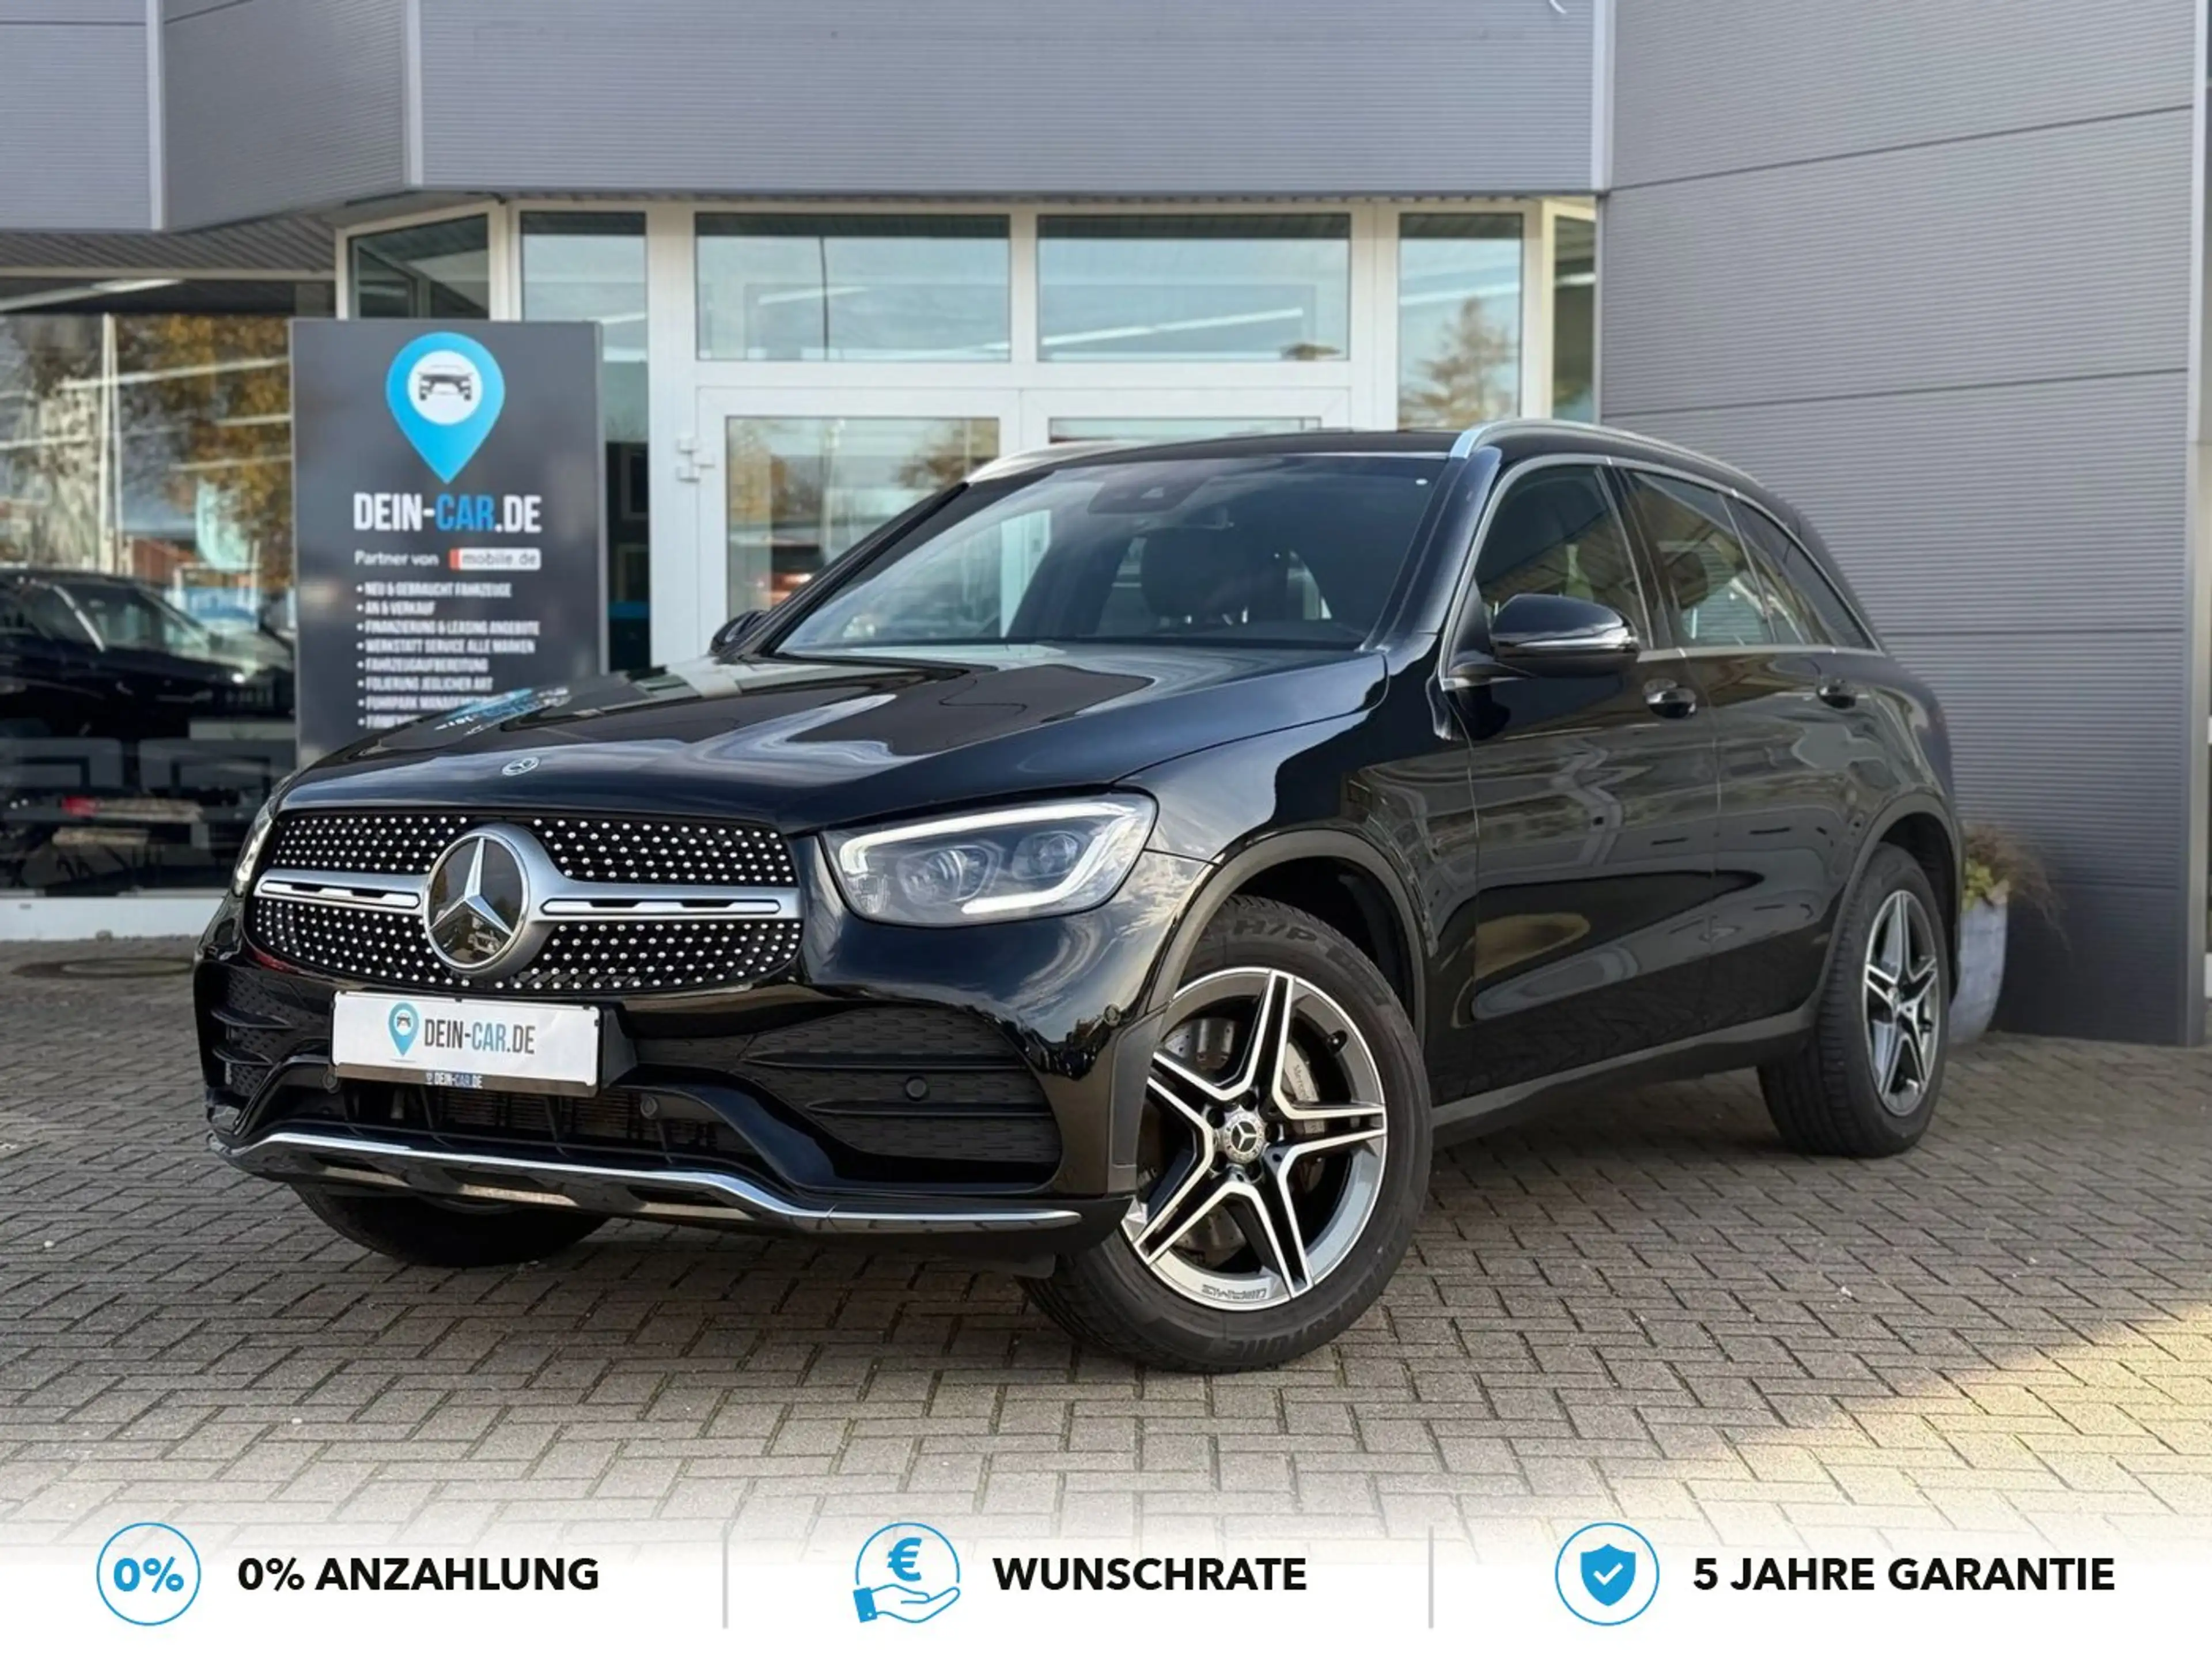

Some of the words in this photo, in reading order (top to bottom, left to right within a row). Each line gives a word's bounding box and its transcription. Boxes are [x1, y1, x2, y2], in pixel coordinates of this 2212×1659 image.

[354, 492, 542, 533] DEIN-CAR.DE
[354, 550, 408, 566] Partner
[411, 554, 440, 566] von
[390, 600, 436, 615] VERKAUF
[365, 619, 436, 635] FINANZIERUNG
[446, 620, 488, 635] LEASING
[365, 638, 423, 654] WERKSTATT
[425, 639, 465, 654] SERVICE
[467, 639, 490, 654] ALLE
[425, 1018, 535, 1054] DEIN-CAR.DE
[434, 1072, 483, 1088] DEIN-CAR.DE
